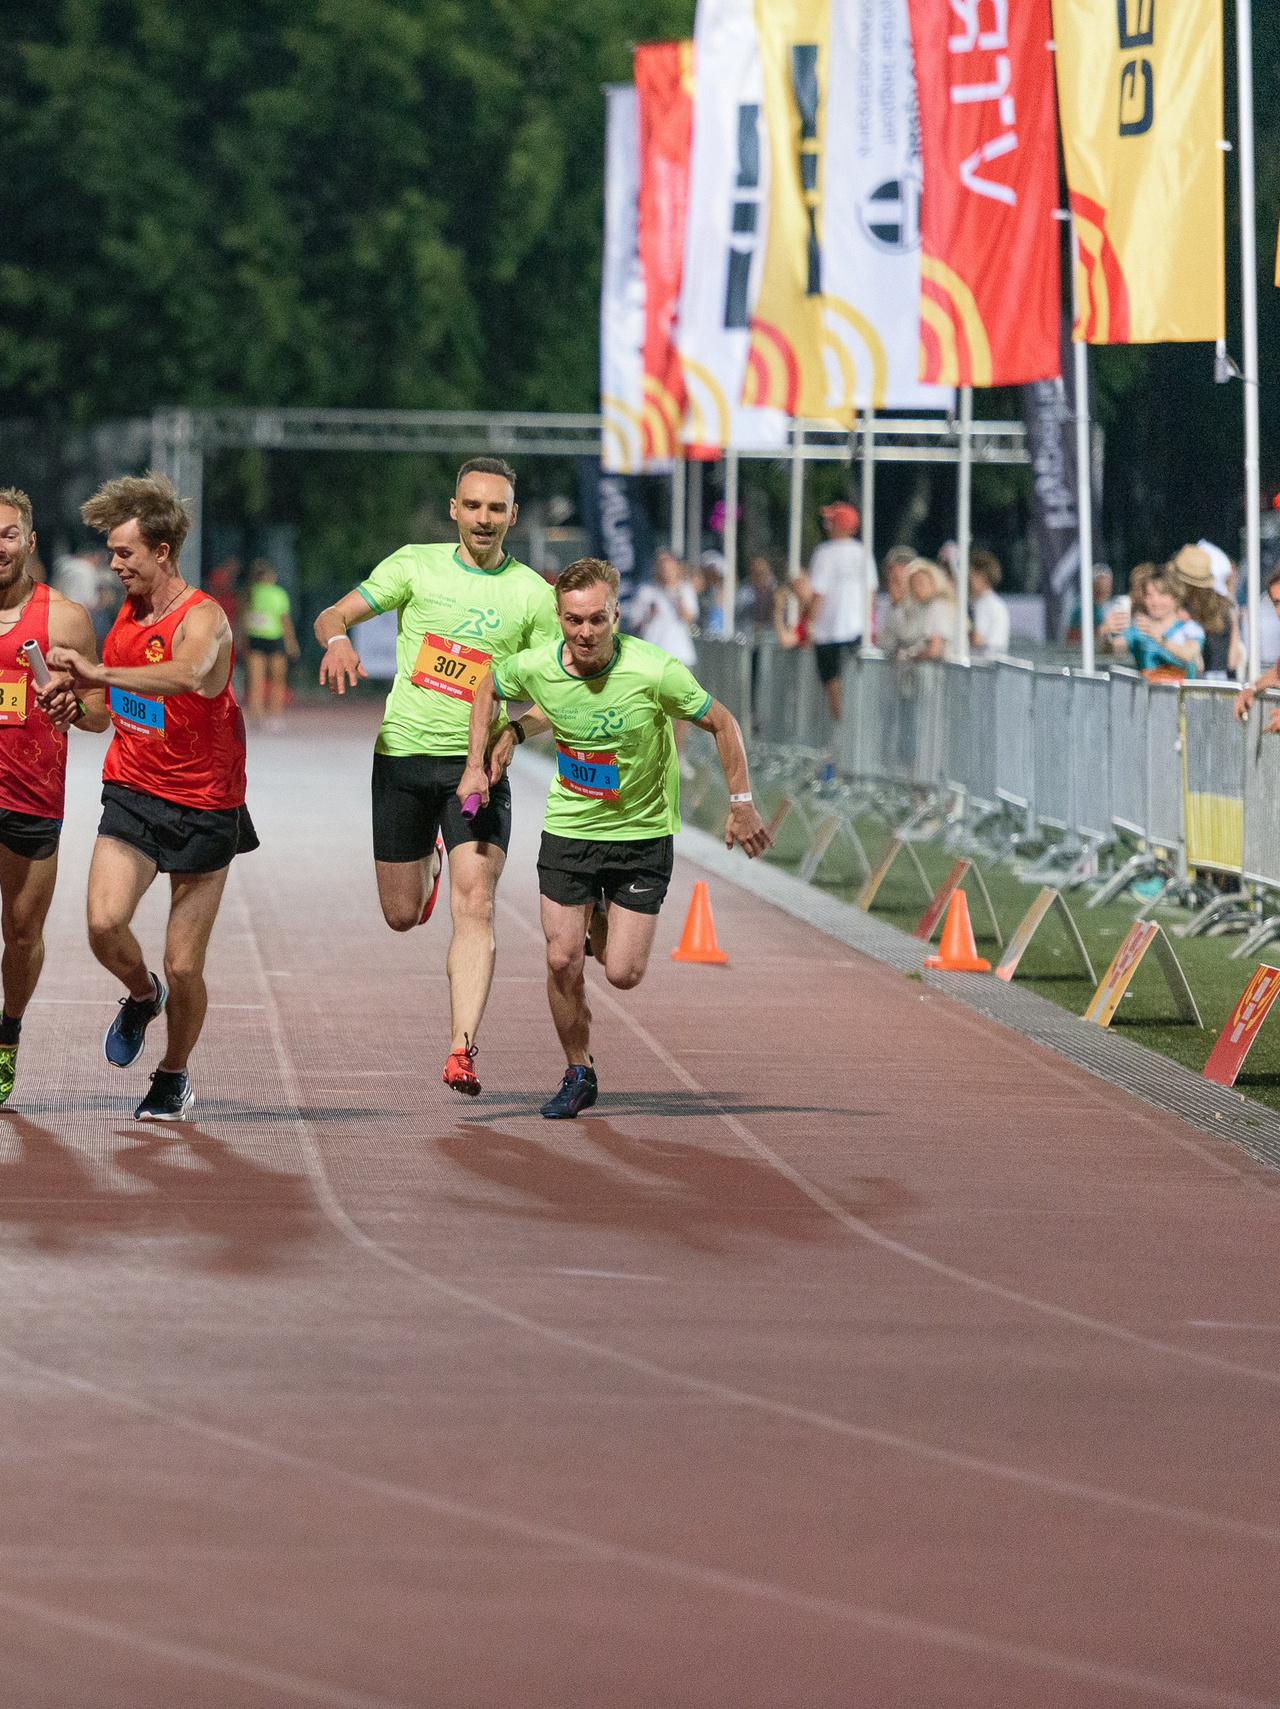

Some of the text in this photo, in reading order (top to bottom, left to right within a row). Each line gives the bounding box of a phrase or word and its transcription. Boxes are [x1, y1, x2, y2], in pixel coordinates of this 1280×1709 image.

[433, 655, 477, 685] 307 2
[11, 696, 18, 706] 2
[122, 696, 157, 723] 308 3
[570, 763, 611, 785] 307 3
